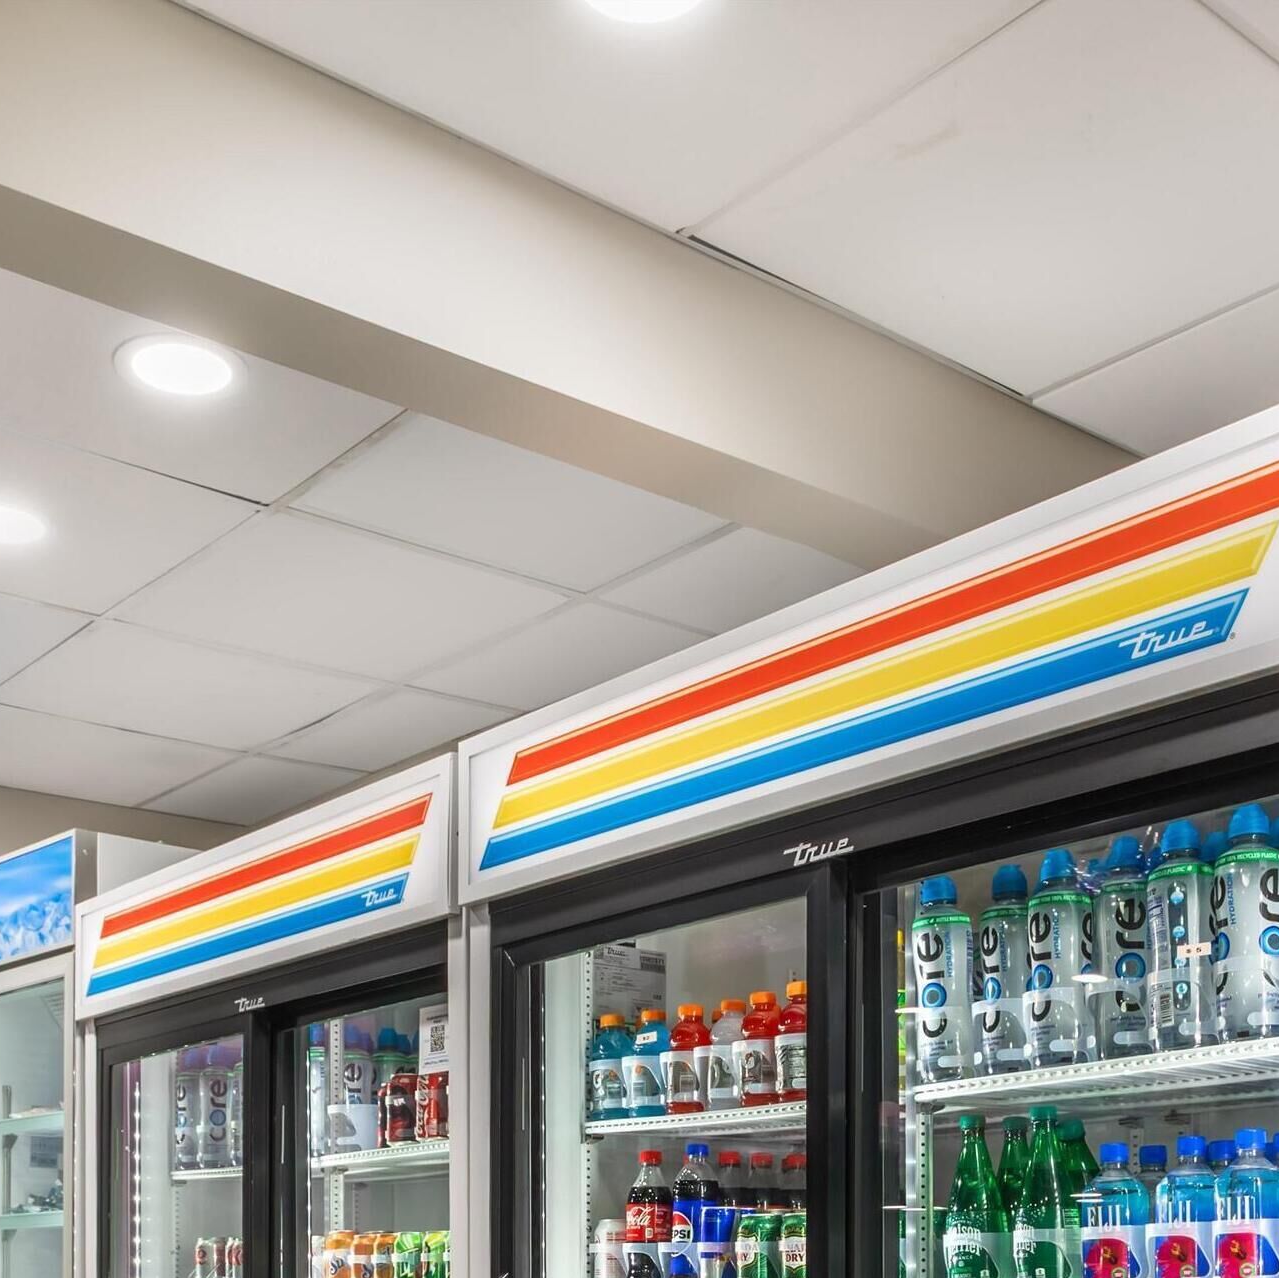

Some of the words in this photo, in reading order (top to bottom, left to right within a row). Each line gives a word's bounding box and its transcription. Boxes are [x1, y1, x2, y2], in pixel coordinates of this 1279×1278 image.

[916, 932, 948, 1038] core
[980, 925, 1003, 1033] core
[1029, 911, 1054, 1023] core
[209, 1076, 227, 1142] core
[1087, 1204, 1121, 1232] FIJI
